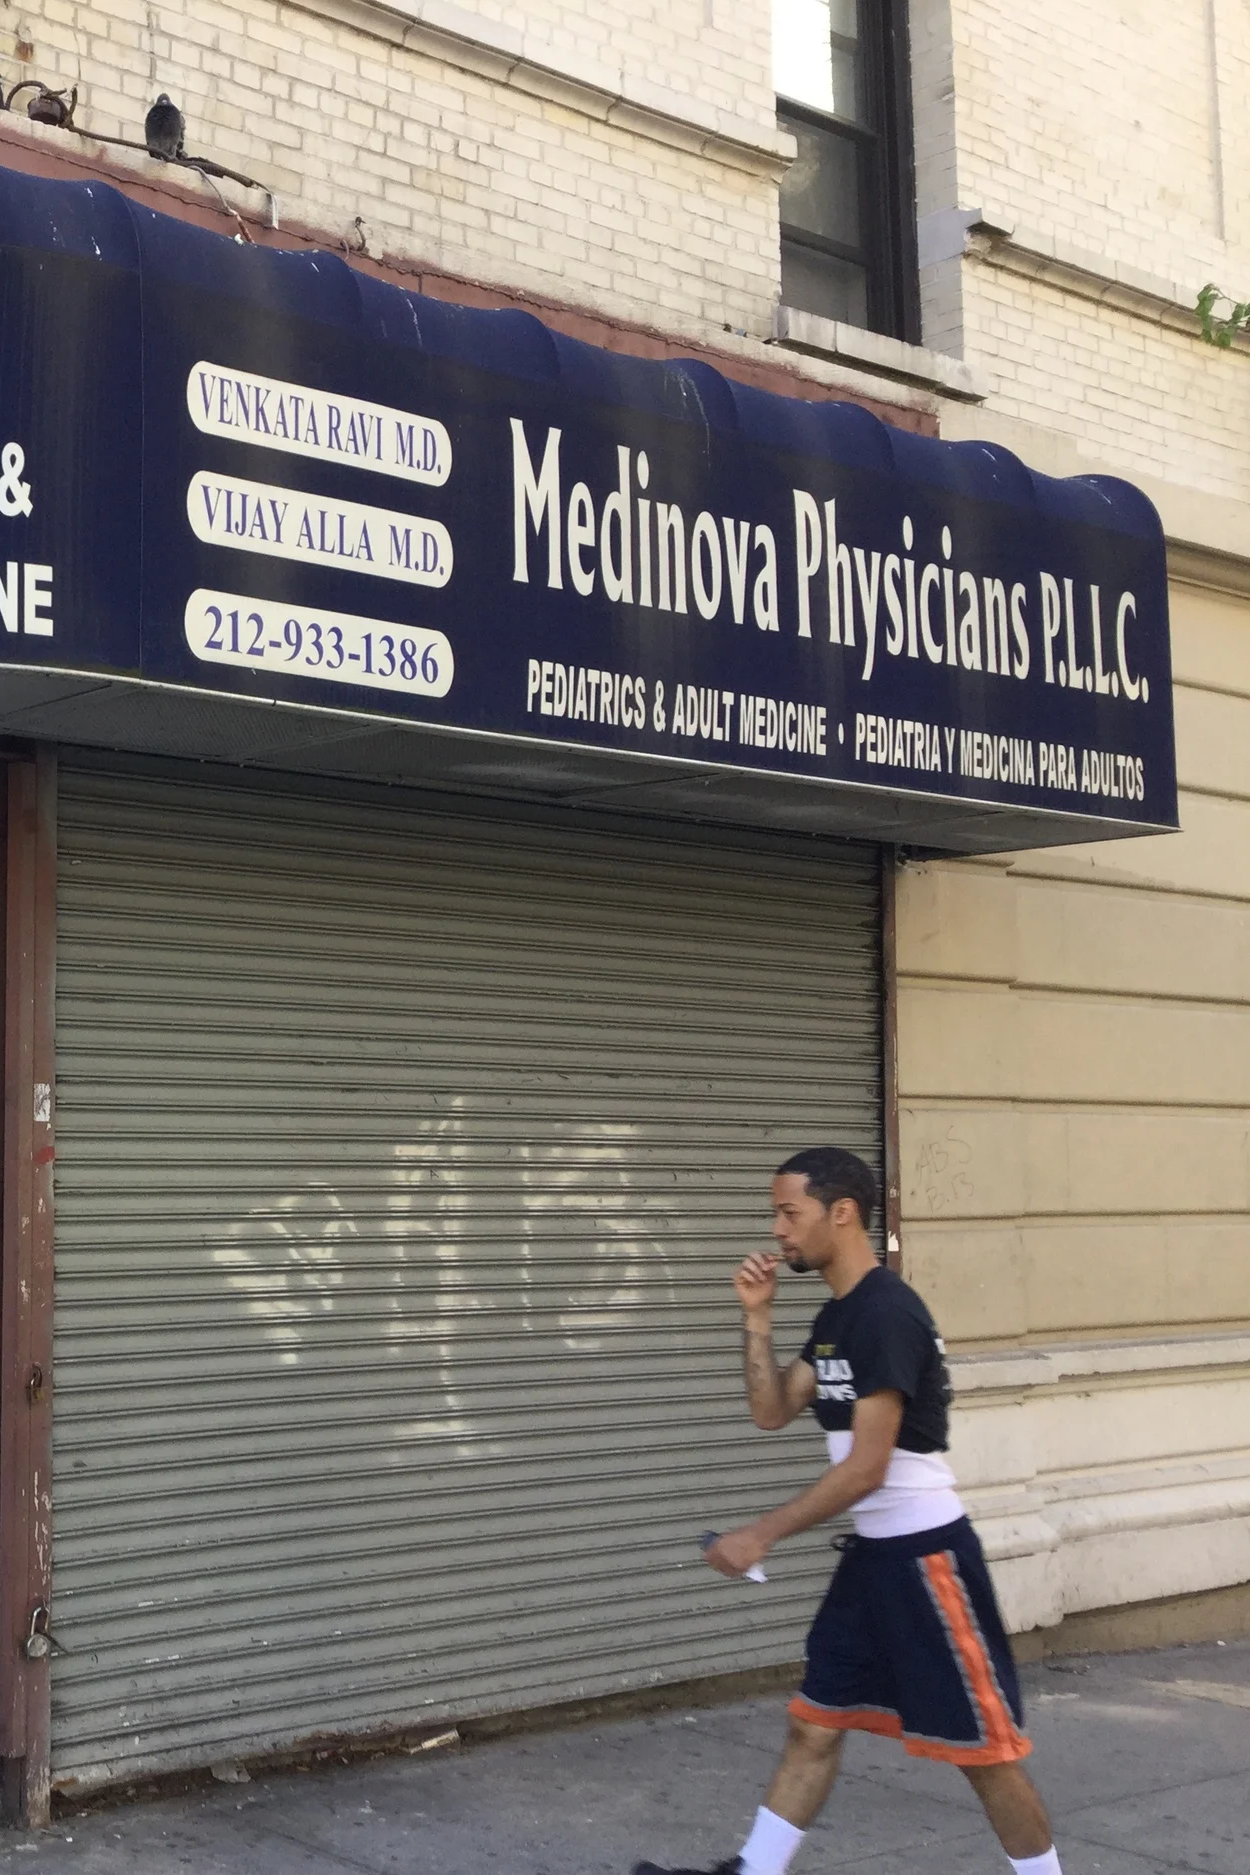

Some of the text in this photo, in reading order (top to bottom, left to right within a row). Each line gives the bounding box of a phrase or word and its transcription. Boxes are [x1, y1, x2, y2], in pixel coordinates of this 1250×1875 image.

[198, 371, 442, 475] VENKATA RAVI M.D.
[201, 484, 444, 577] VIJAY ALLA M.D.
[510, 418, 1148, 703] Medinova Physicians P.L.L.C.
[203, 605, 439, 684] 212-933-1386
[527, 658, 1144, 801] PEDIATRICS & ADULT MEDICINE PEDIATRIA Y MEDICINA PARA ADULTOS
